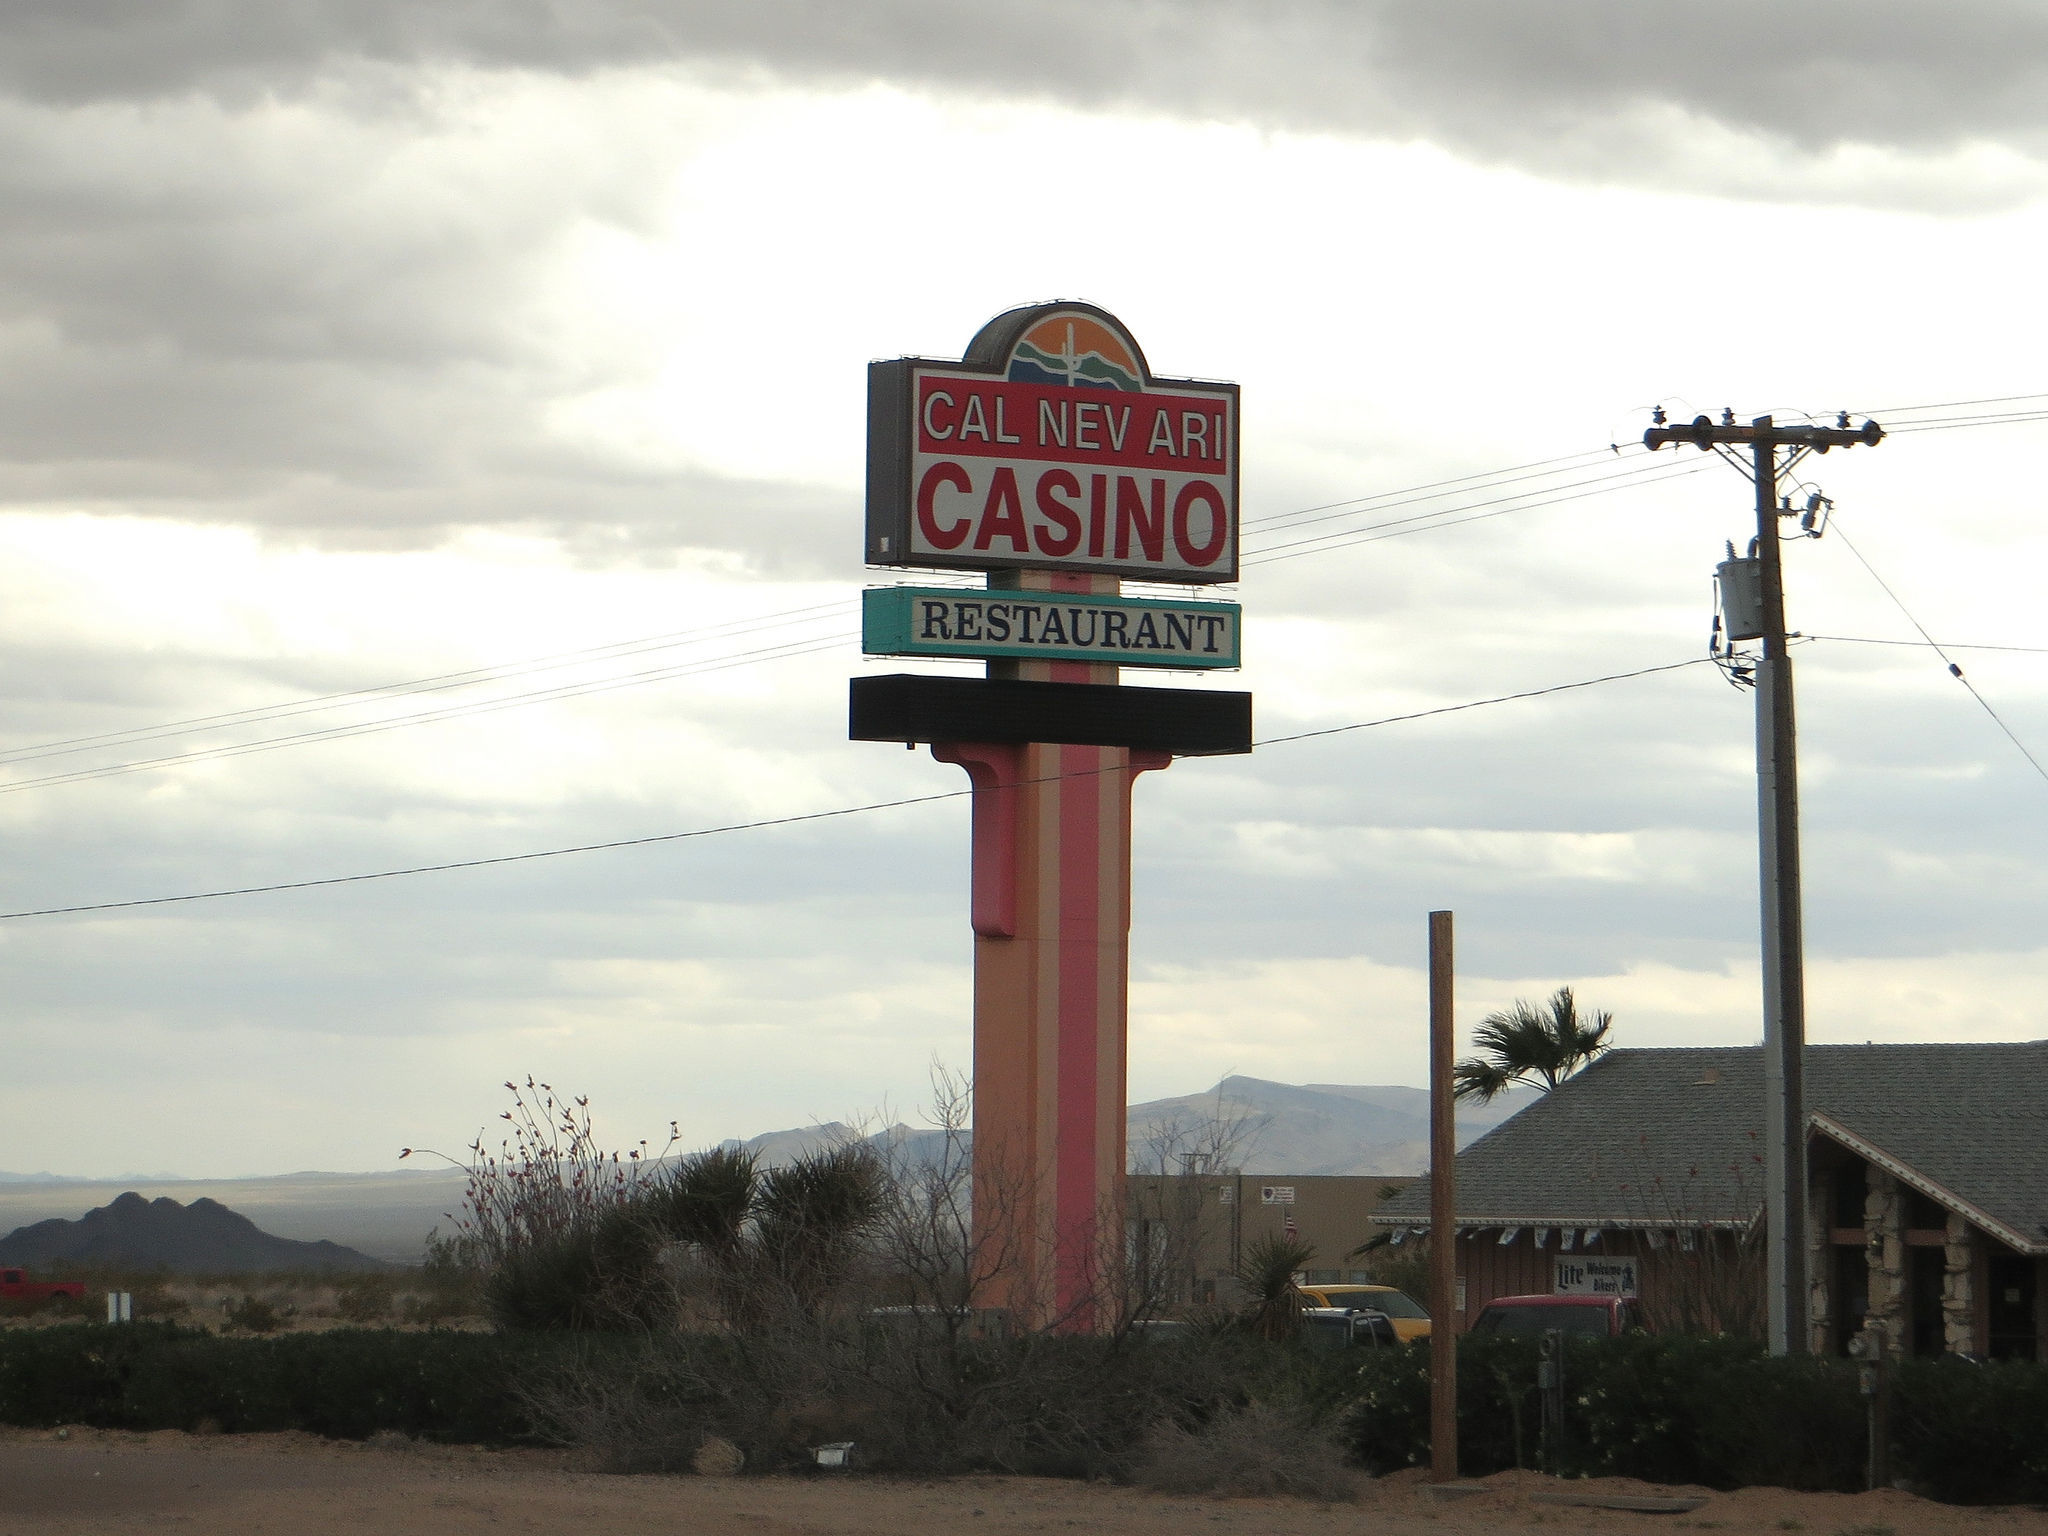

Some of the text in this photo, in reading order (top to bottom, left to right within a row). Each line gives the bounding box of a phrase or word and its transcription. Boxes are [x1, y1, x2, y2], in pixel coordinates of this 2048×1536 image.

[923, 390, 1223, 460] CAL NEV ARI
[916, 461, 1228, 568] CASINO
[920, 600, 1225, 653] RESTAURANT
[1558, 1264, 1584, 1290] Lite
